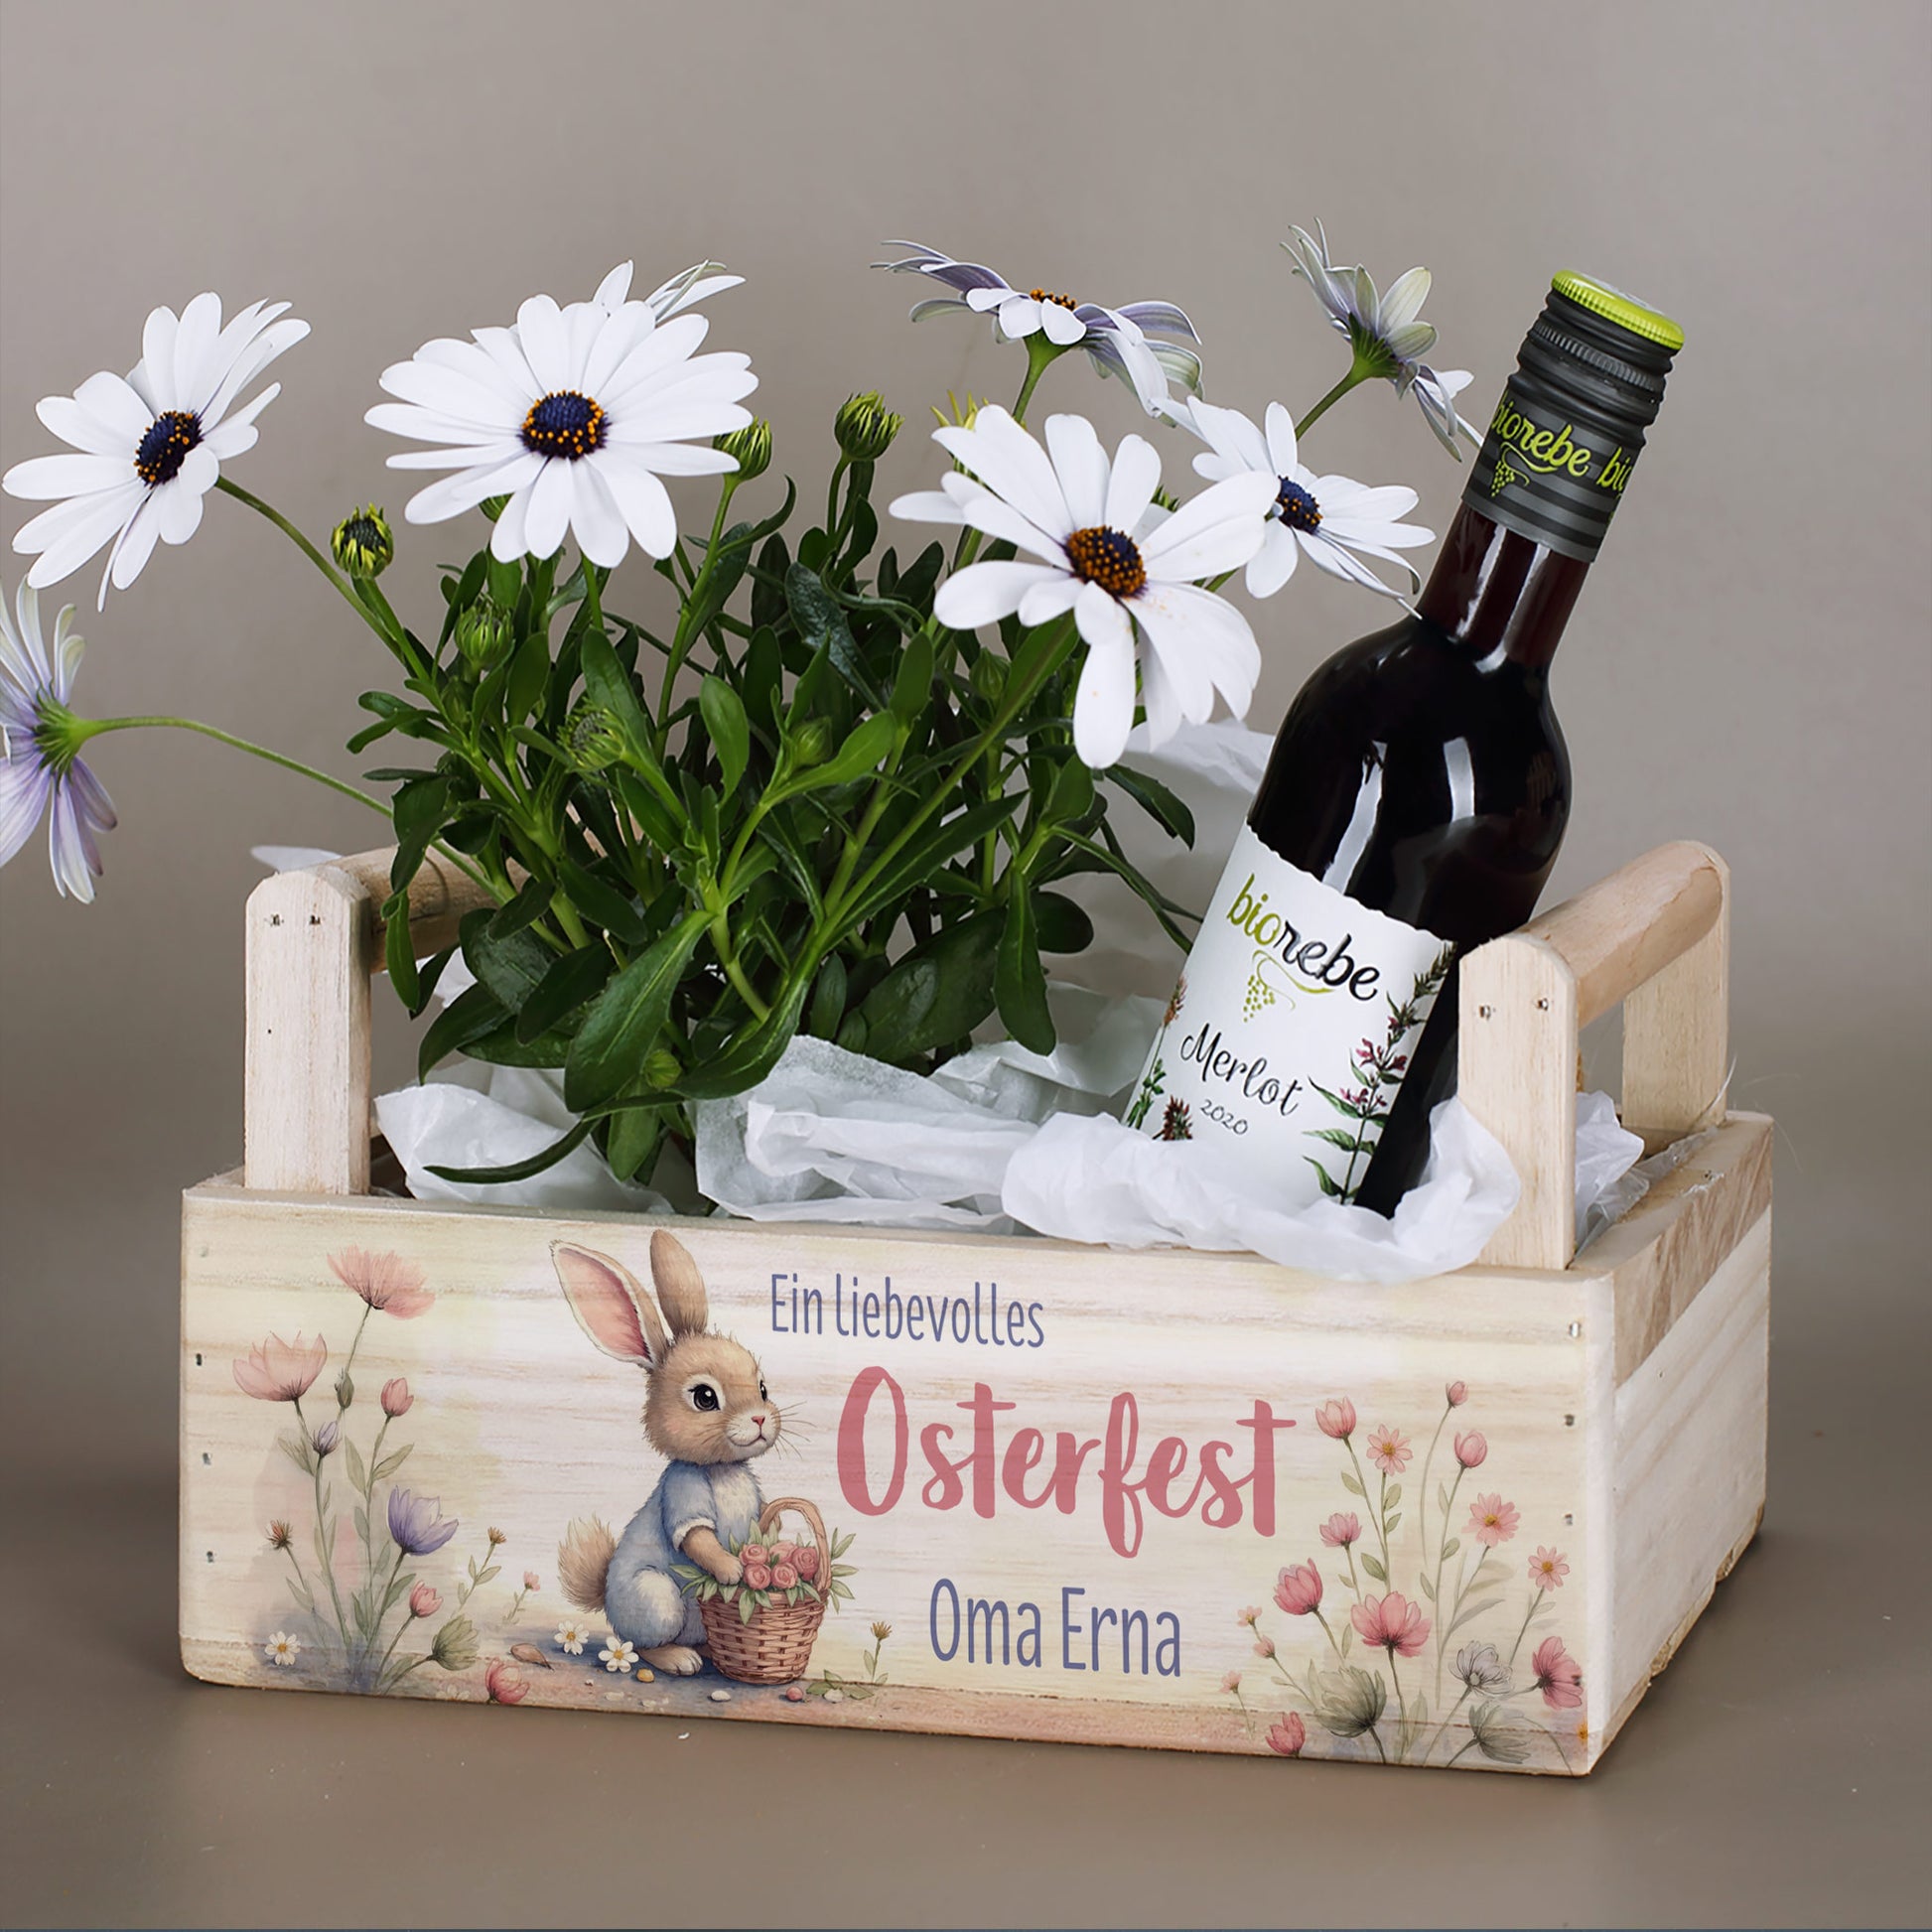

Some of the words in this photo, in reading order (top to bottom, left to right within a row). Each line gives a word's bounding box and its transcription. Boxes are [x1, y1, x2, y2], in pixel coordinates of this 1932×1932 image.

[1227, 874, 1380, 1001] biorebe
[1180, 1023, 1303, 1116] Merlot
[1199, 1099, 1249, 1136] 2020
[771, 1273, 823, 1335] Ein
[835, 1273, 1045, 1348] liebevolles
[837, 1366, 1297, 1559] Osterfest
[929, 1579, 1042, 1668] Oma
[1061, 1587, 1181, 1678] Erna
